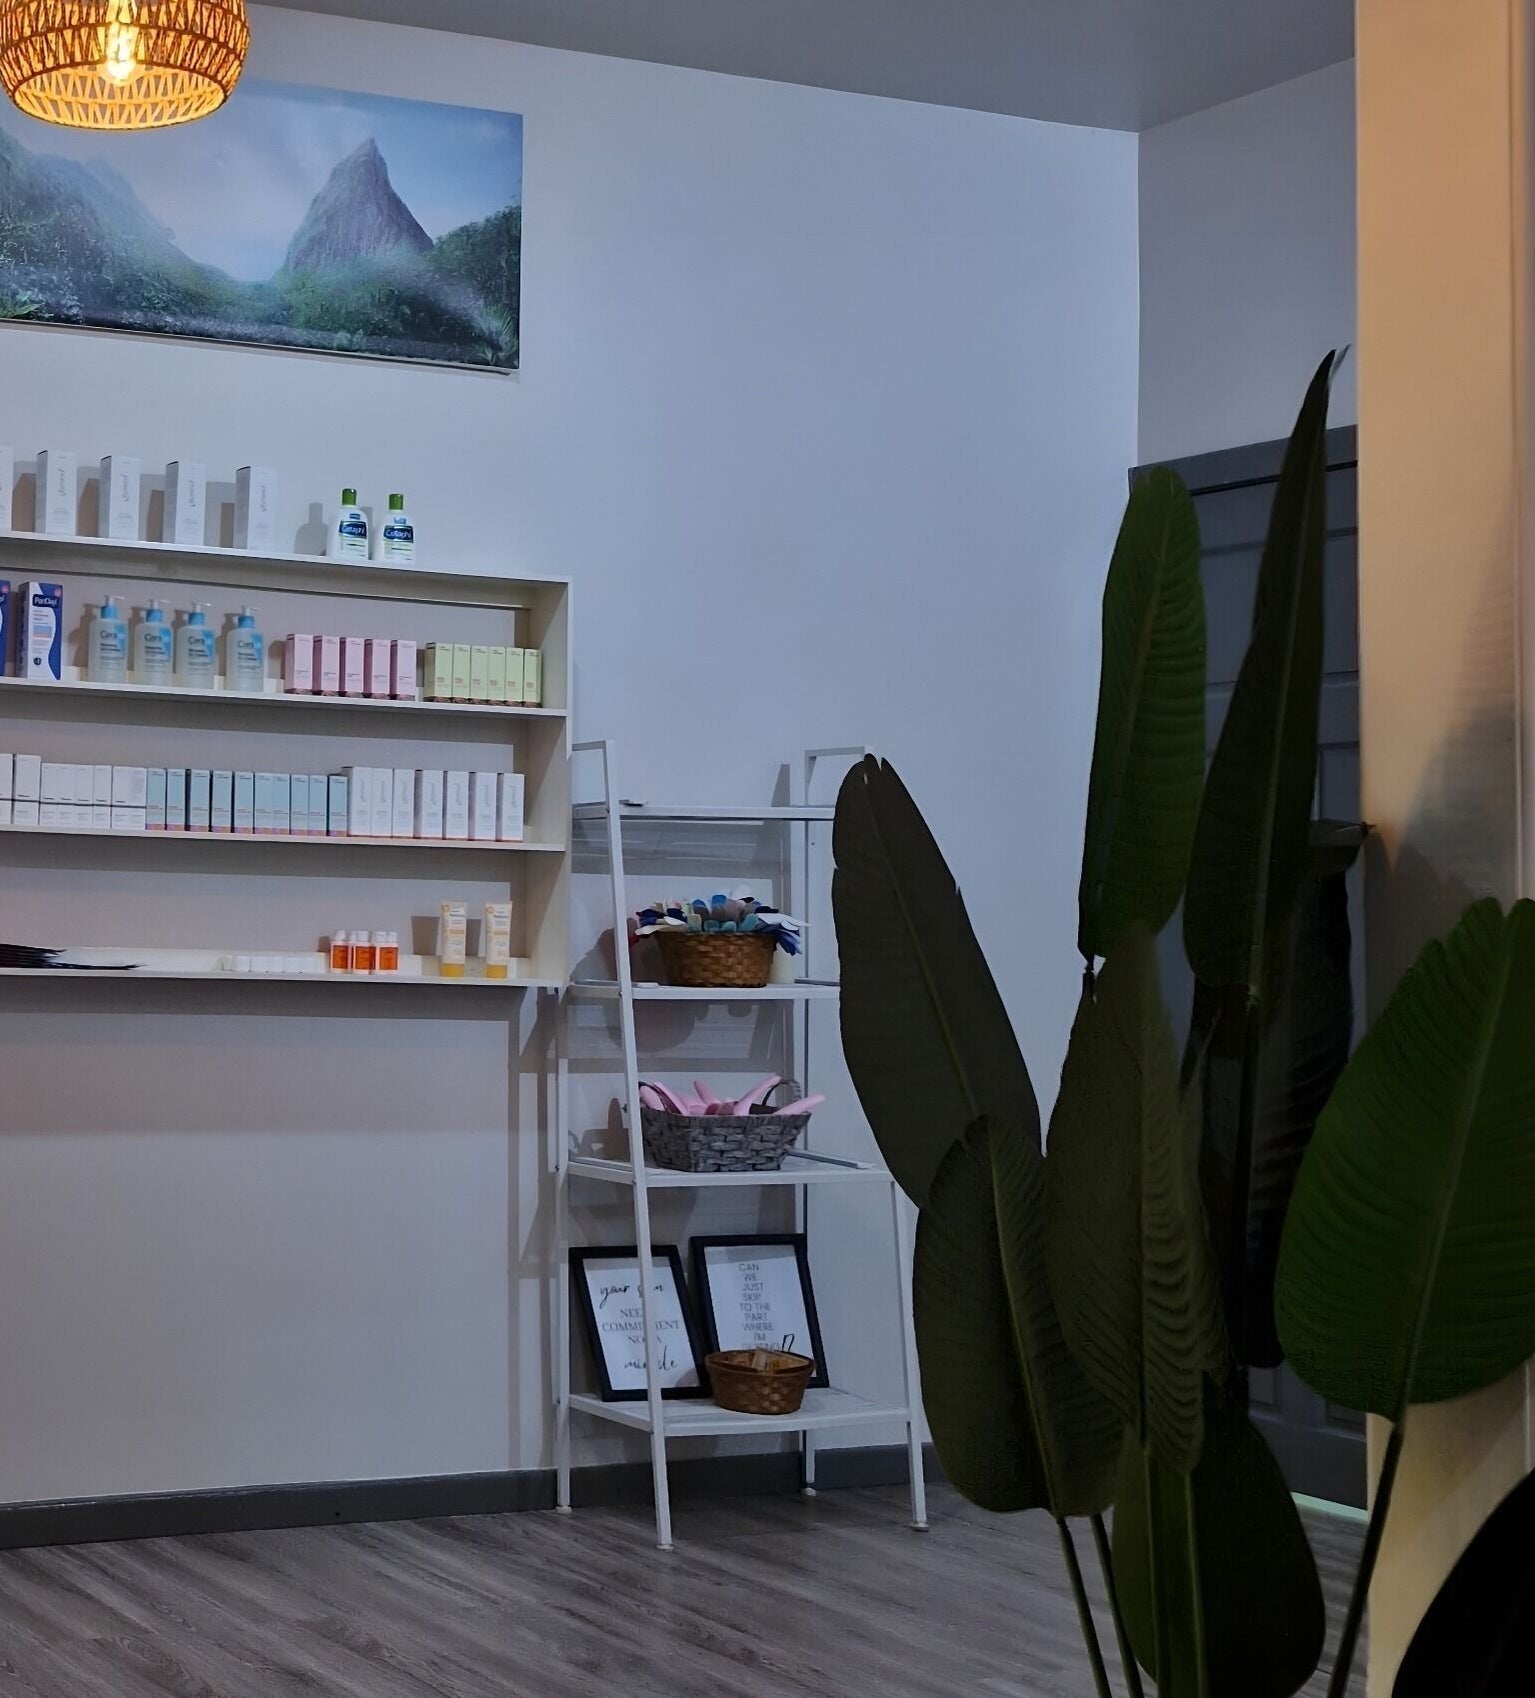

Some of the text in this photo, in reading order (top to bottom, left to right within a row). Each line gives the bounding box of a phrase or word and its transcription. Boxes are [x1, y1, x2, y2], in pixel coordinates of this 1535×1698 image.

[738, 1263, 759, 1272] CAN
[743, 1282, 763, 1291] JUST
[740, 1302, 771, 1311] TO THE
[744, 1312, 768, 1321] PART
[743, 1322, 773, 1331] WHERE
